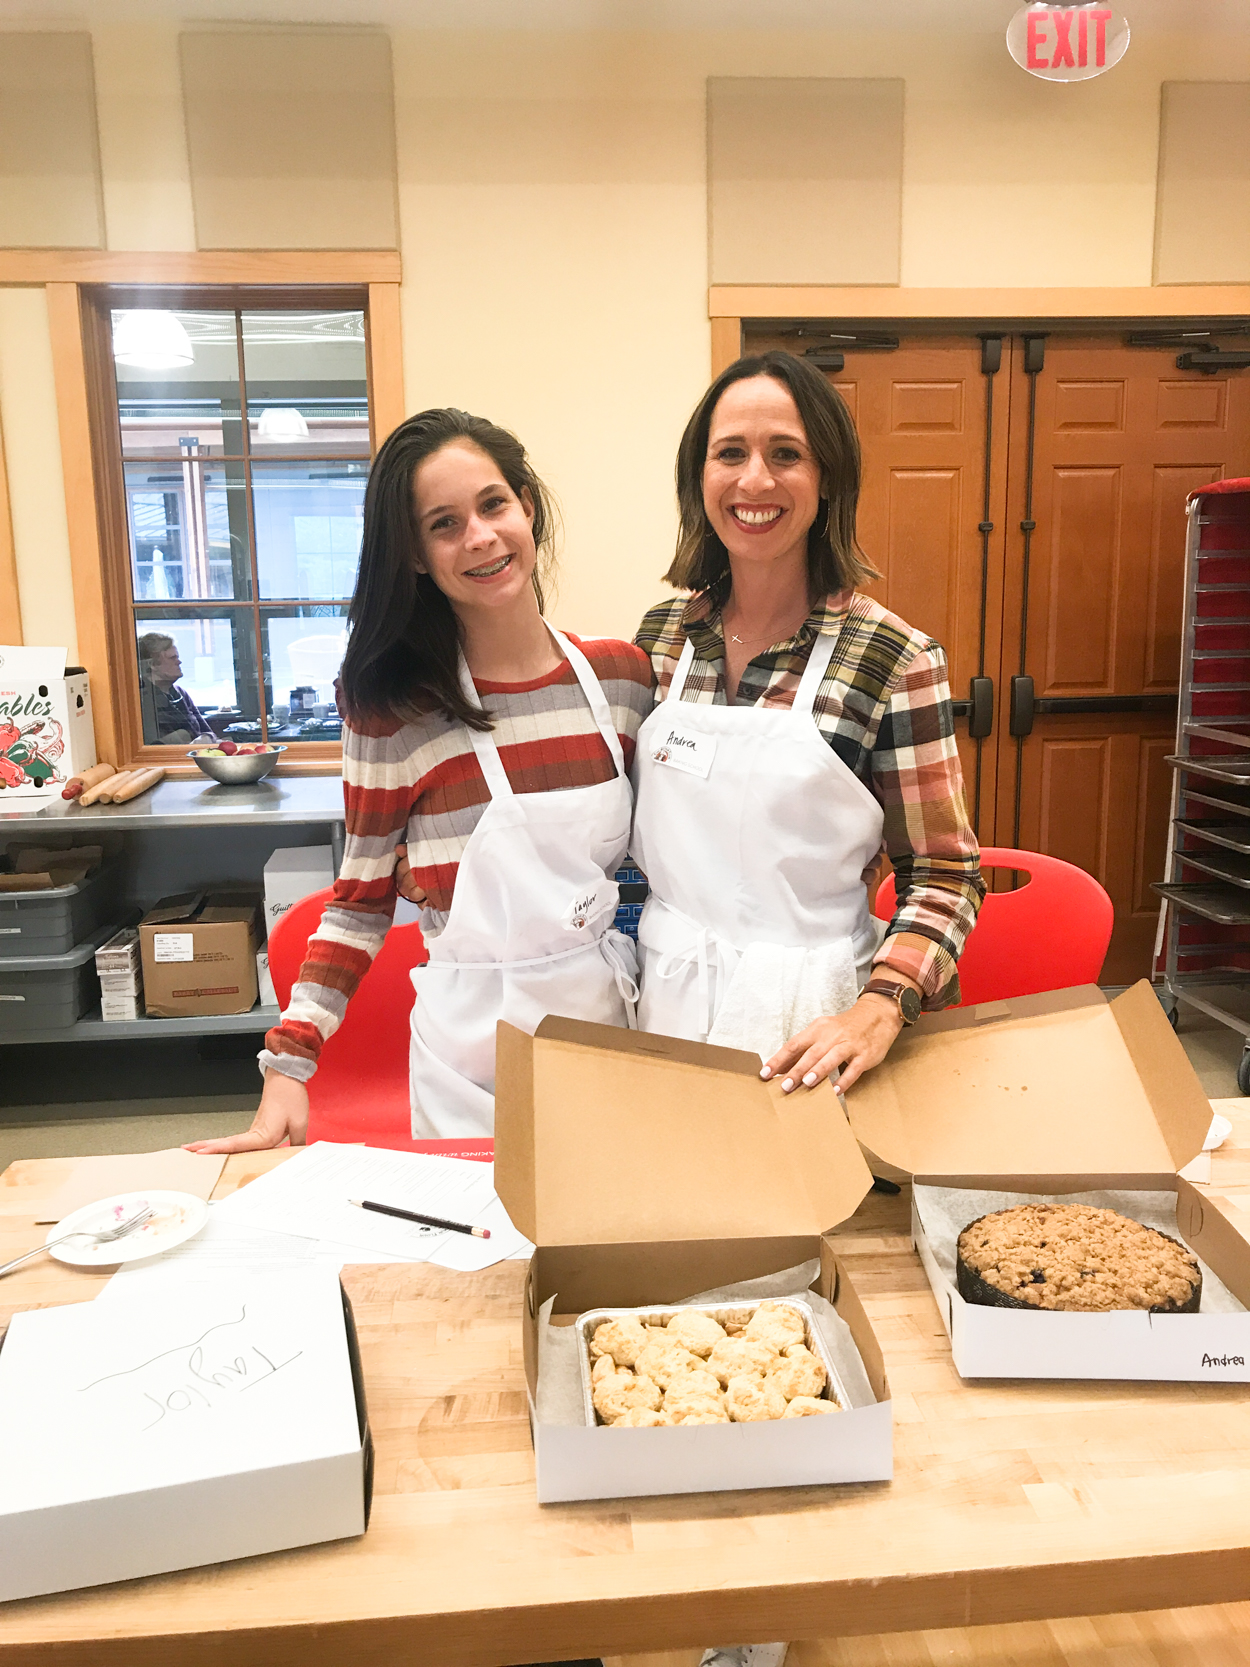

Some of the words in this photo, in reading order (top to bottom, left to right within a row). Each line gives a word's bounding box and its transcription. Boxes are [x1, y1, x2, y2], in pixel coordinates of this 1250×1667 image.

[1027, 10, 1112, 69] EXIT
[666, 730, 697, 751] Andrea
[1201, 1353, 1245, 1368] Andrea
[142, 1346, 303, 1432] Taylor
